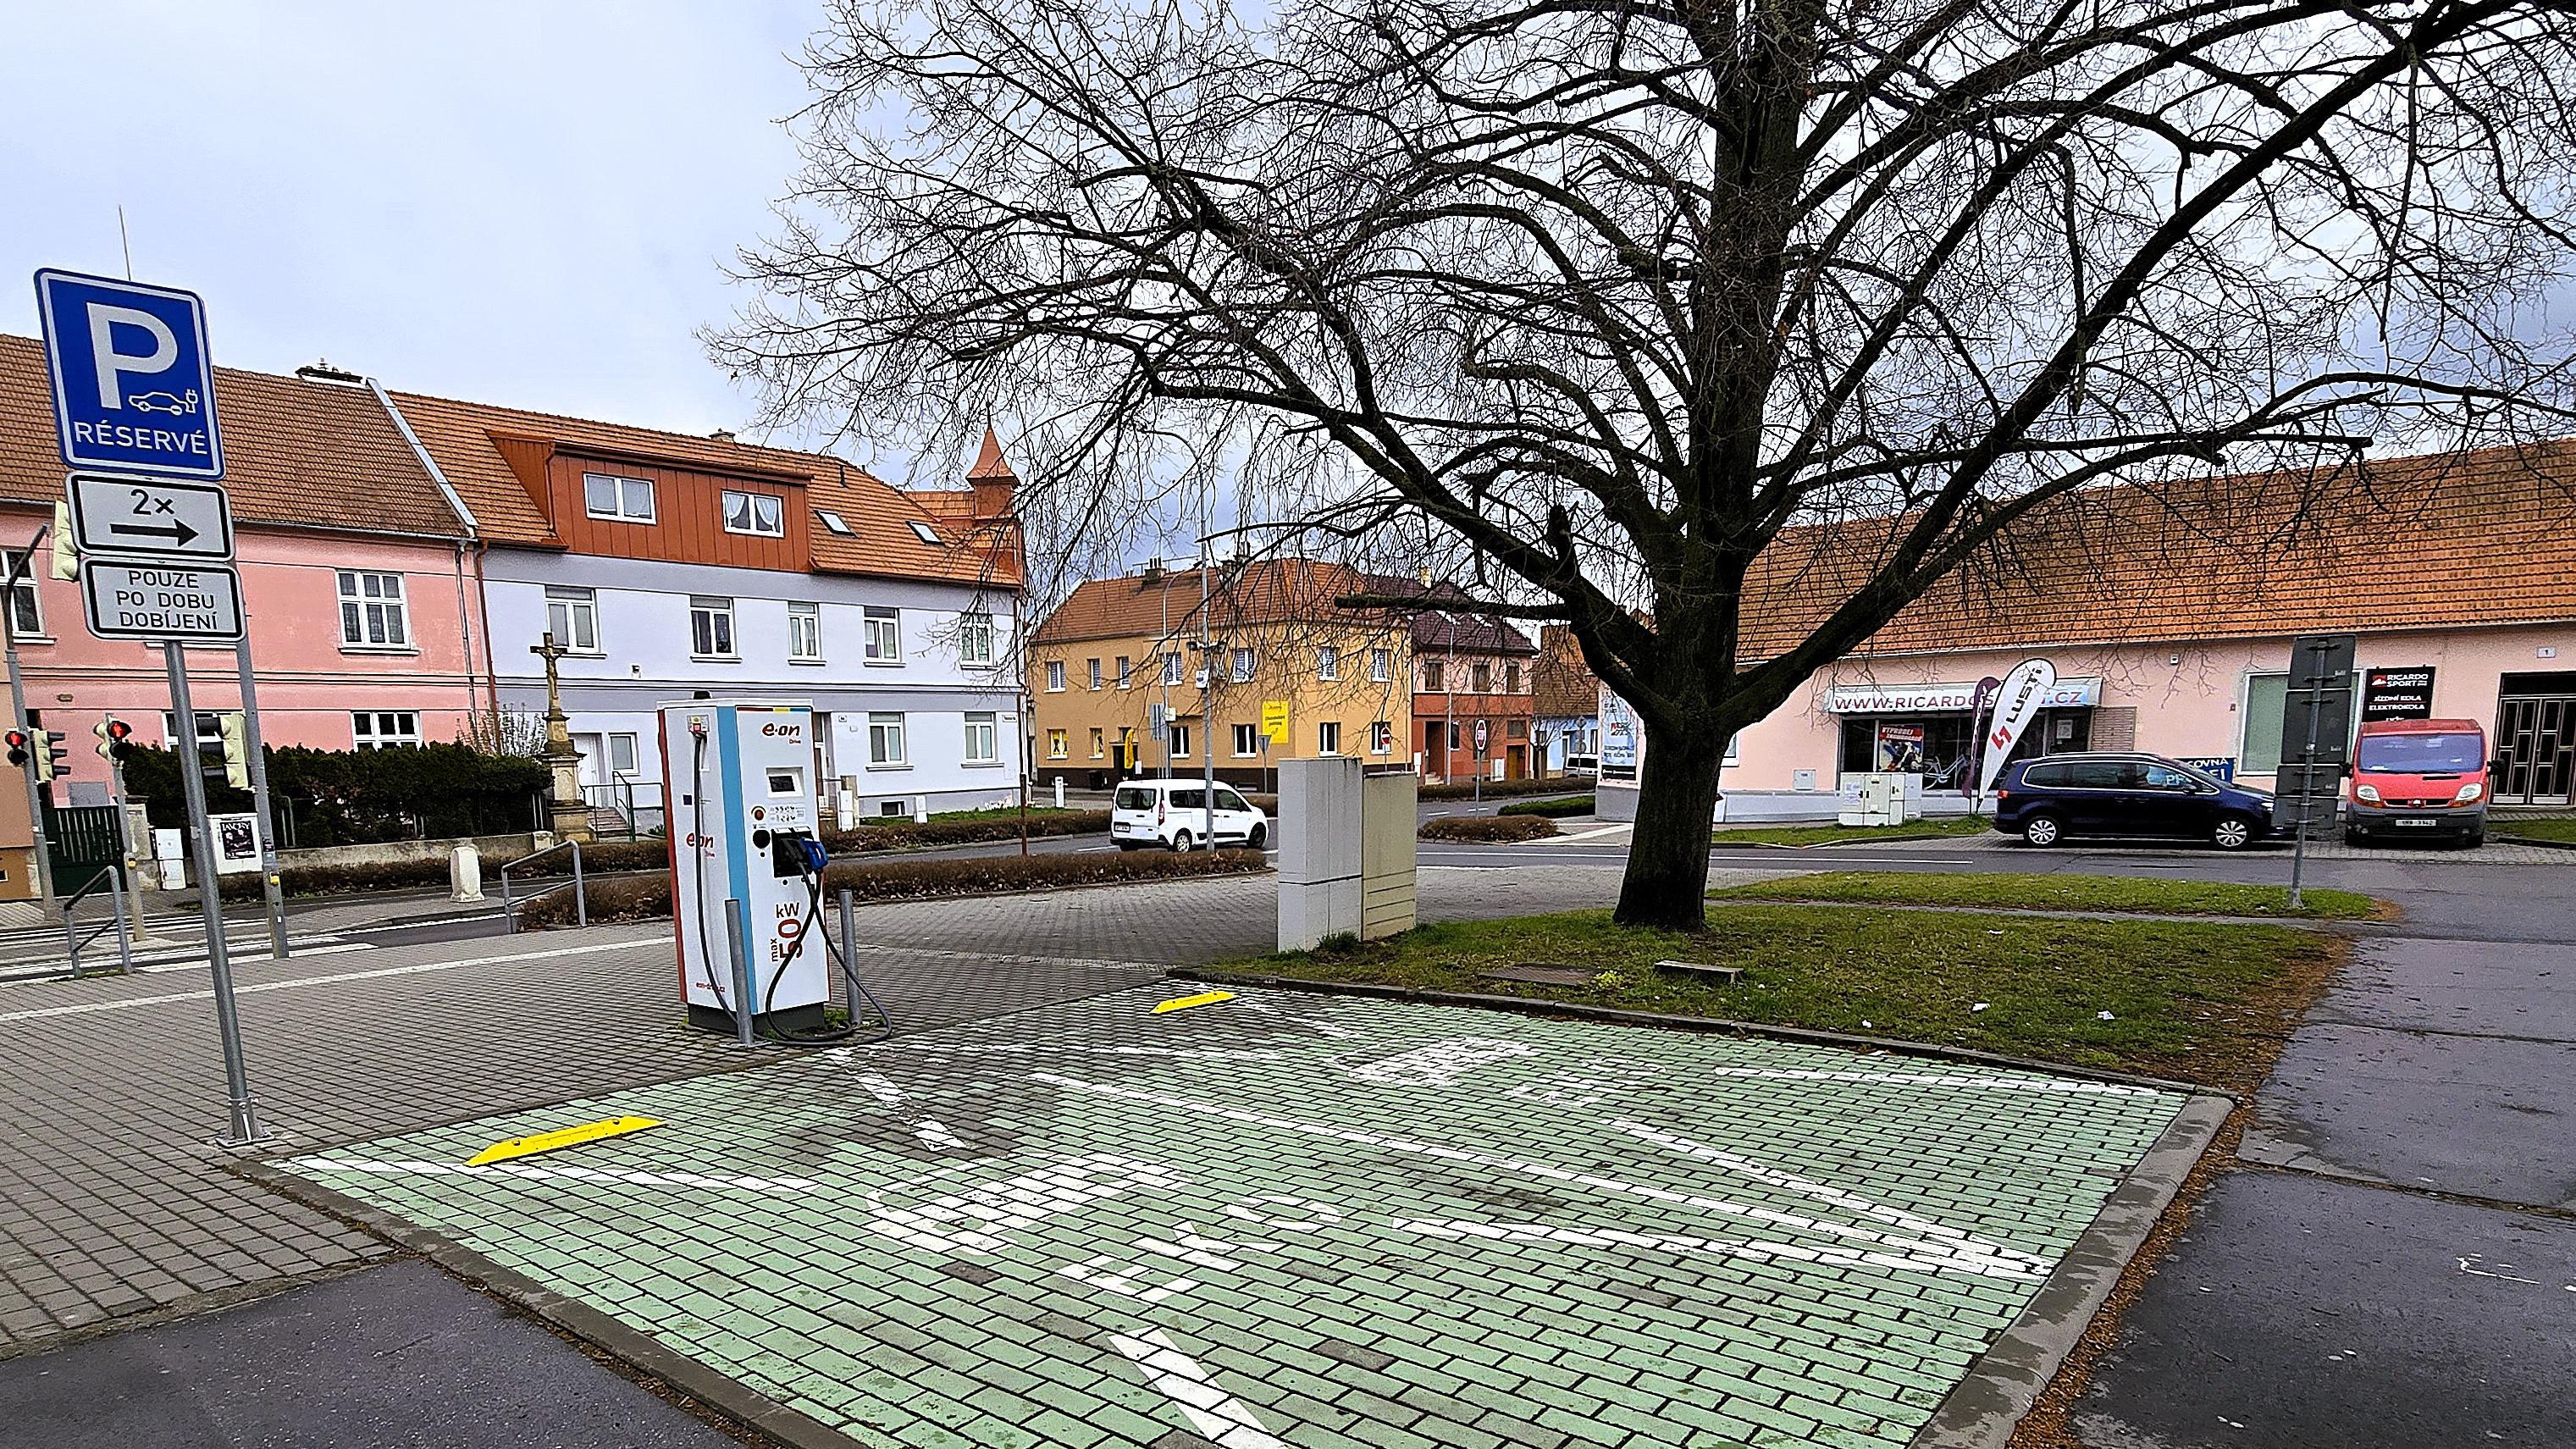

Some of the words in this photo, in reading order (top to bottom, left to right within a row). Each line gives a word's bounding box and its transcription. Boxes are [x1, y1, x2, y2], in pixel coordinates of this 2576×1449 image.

[86, 301, 178, 410] P
[74, 419, 208, 456] RÉSERVÉ
[129, 570, 200, 589] POUZE
[117, 589, 146, 607] PO
[158, 592, 215, 610] DOBU
[119, 611, 218, 631] DOBÍJENÍ
[1835, 691, 2082, 710] WWW.RICARDS.CZ
[775, 902, 800, 918] kW
[777, 918, 804, 959] 50
[770, 937, 778, 962] max
